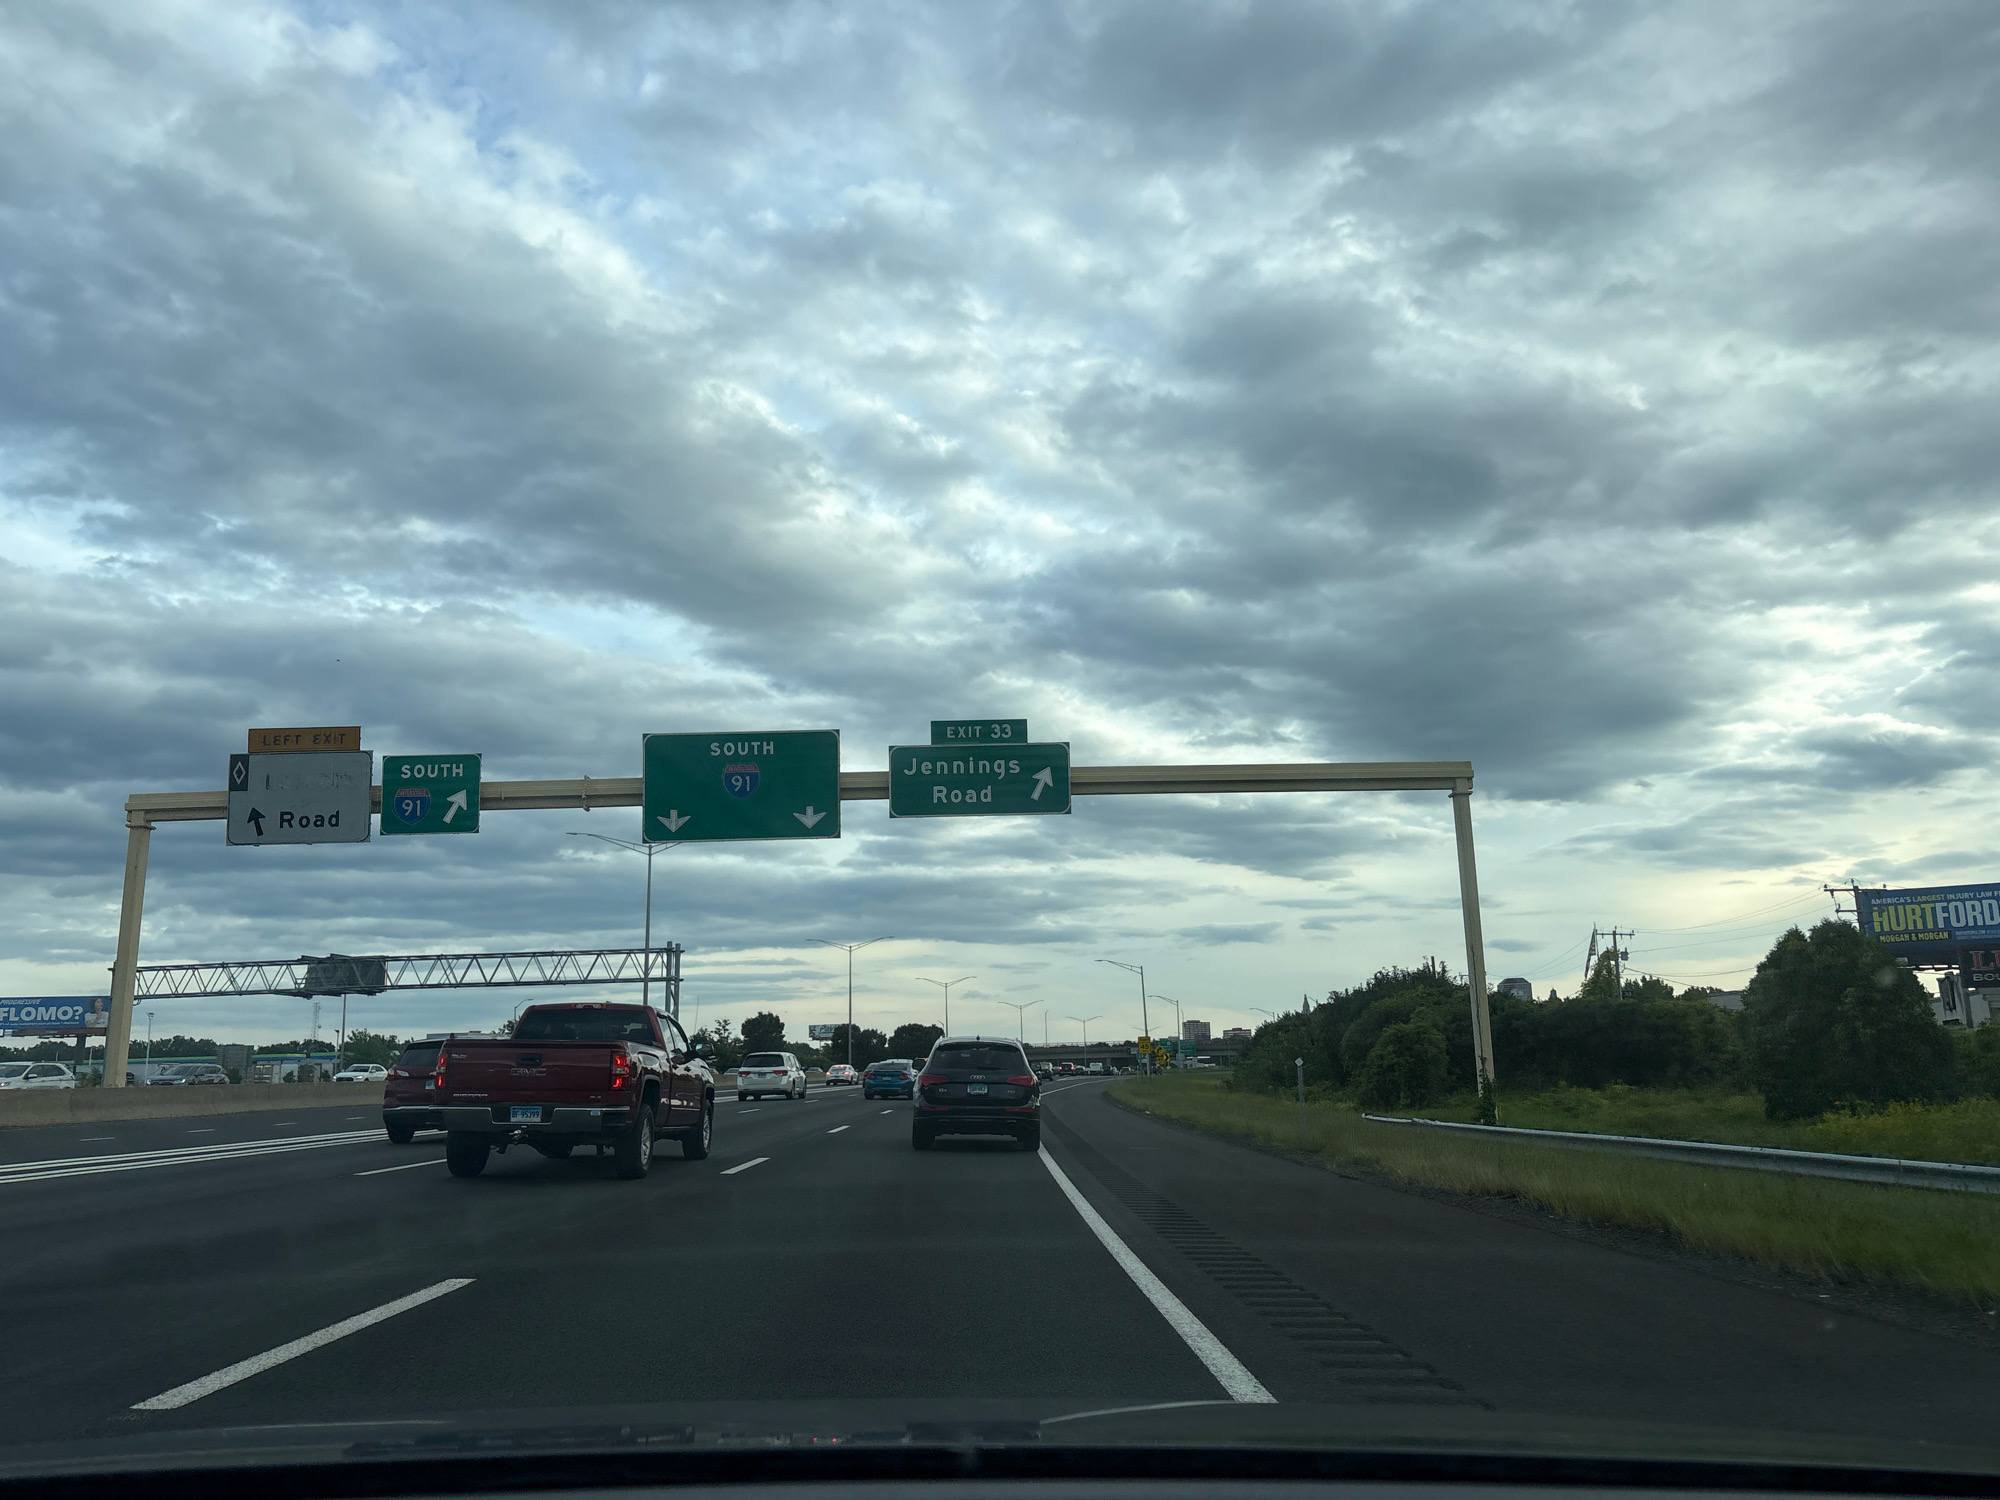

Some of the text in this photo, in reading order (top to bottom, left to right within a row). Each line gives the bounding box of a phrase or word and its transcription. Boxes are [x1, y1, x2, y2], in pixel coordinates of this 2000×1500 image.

[946, 723, 1012, 739] EXIT 33
[262, 733, 346, 746] LEFT EXIT
[710, 741, 774, 756] SOUTH
[400, 763, 464, 779] SOUTH
[903, 756, 1021, 780] Jennings
[731, 775, 751, 792] 91
[932, 785, 992, 804] Road
[401, 799, 421, 817] 91
[279, 810, 340, 829] Road
[1871, 896, 1911, 905] AMERICA'S
[1913, 894, 1945, 902] LARGEST
[1946, 892, 1974, 900] INJURY
[1976, 890, 1993, 898] LAW
[1879, 933, 1910, 943] MORGAN
[1911, 933, 1917, 941] &
[1918, 931, 1949, 941] MORGAN
[510, 1068, 547, 1077] GMC
